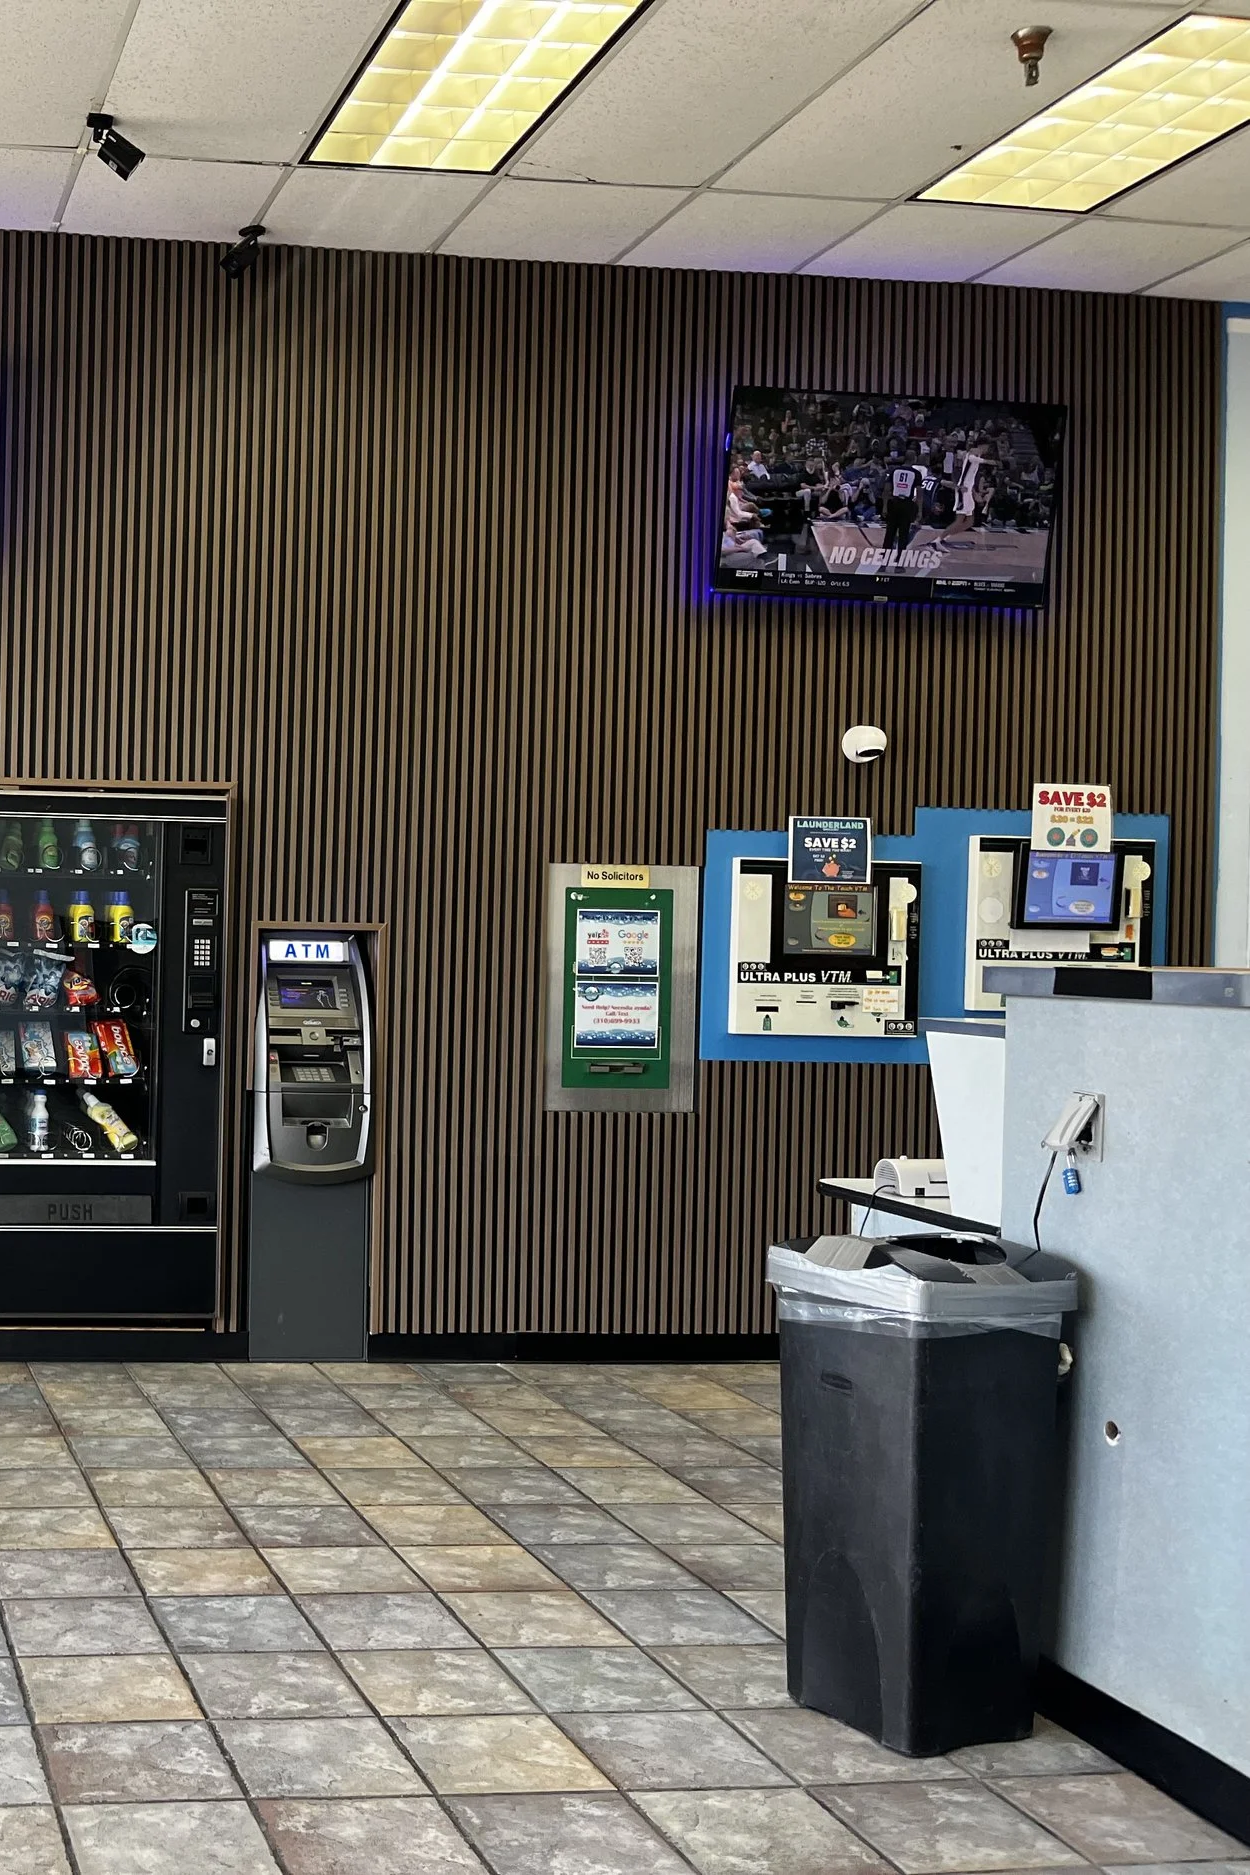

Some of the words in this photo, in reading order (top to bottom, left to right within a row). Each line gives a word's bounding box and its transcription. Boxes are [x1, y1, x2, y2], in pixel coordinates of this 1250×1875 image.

[921, 481, 934, 490] 50
[830, 546, 856, 564] NO
[859, 547, 943, 569] CEILINGS
[736, 570, 758, 578] ESPN
[1038, 791, 1084, 806] SAVE
[1086, 792, 1106, 808] $2
[797, 820, 864, 829] LAUNDERLAND
[804, 837, 839, 848] SAVE
[841, 837, 856, 850] $2
[587, 871, 599, 880] No
[602, 871, 644, 881] Solicitors
[618, 930, 649, 940] Google
[285, 944, 330, 959] ATM
[978, 949, 1018, 959] ULTRA
[1022, 951, 1053, 959] PLUS
[740, 972, 780, 982] ULTRA
[784, 972, 816, 982] PLUS
[111, 1026, 131, 1064] bounce
[48, 1203, 93, 1221] PUSH
